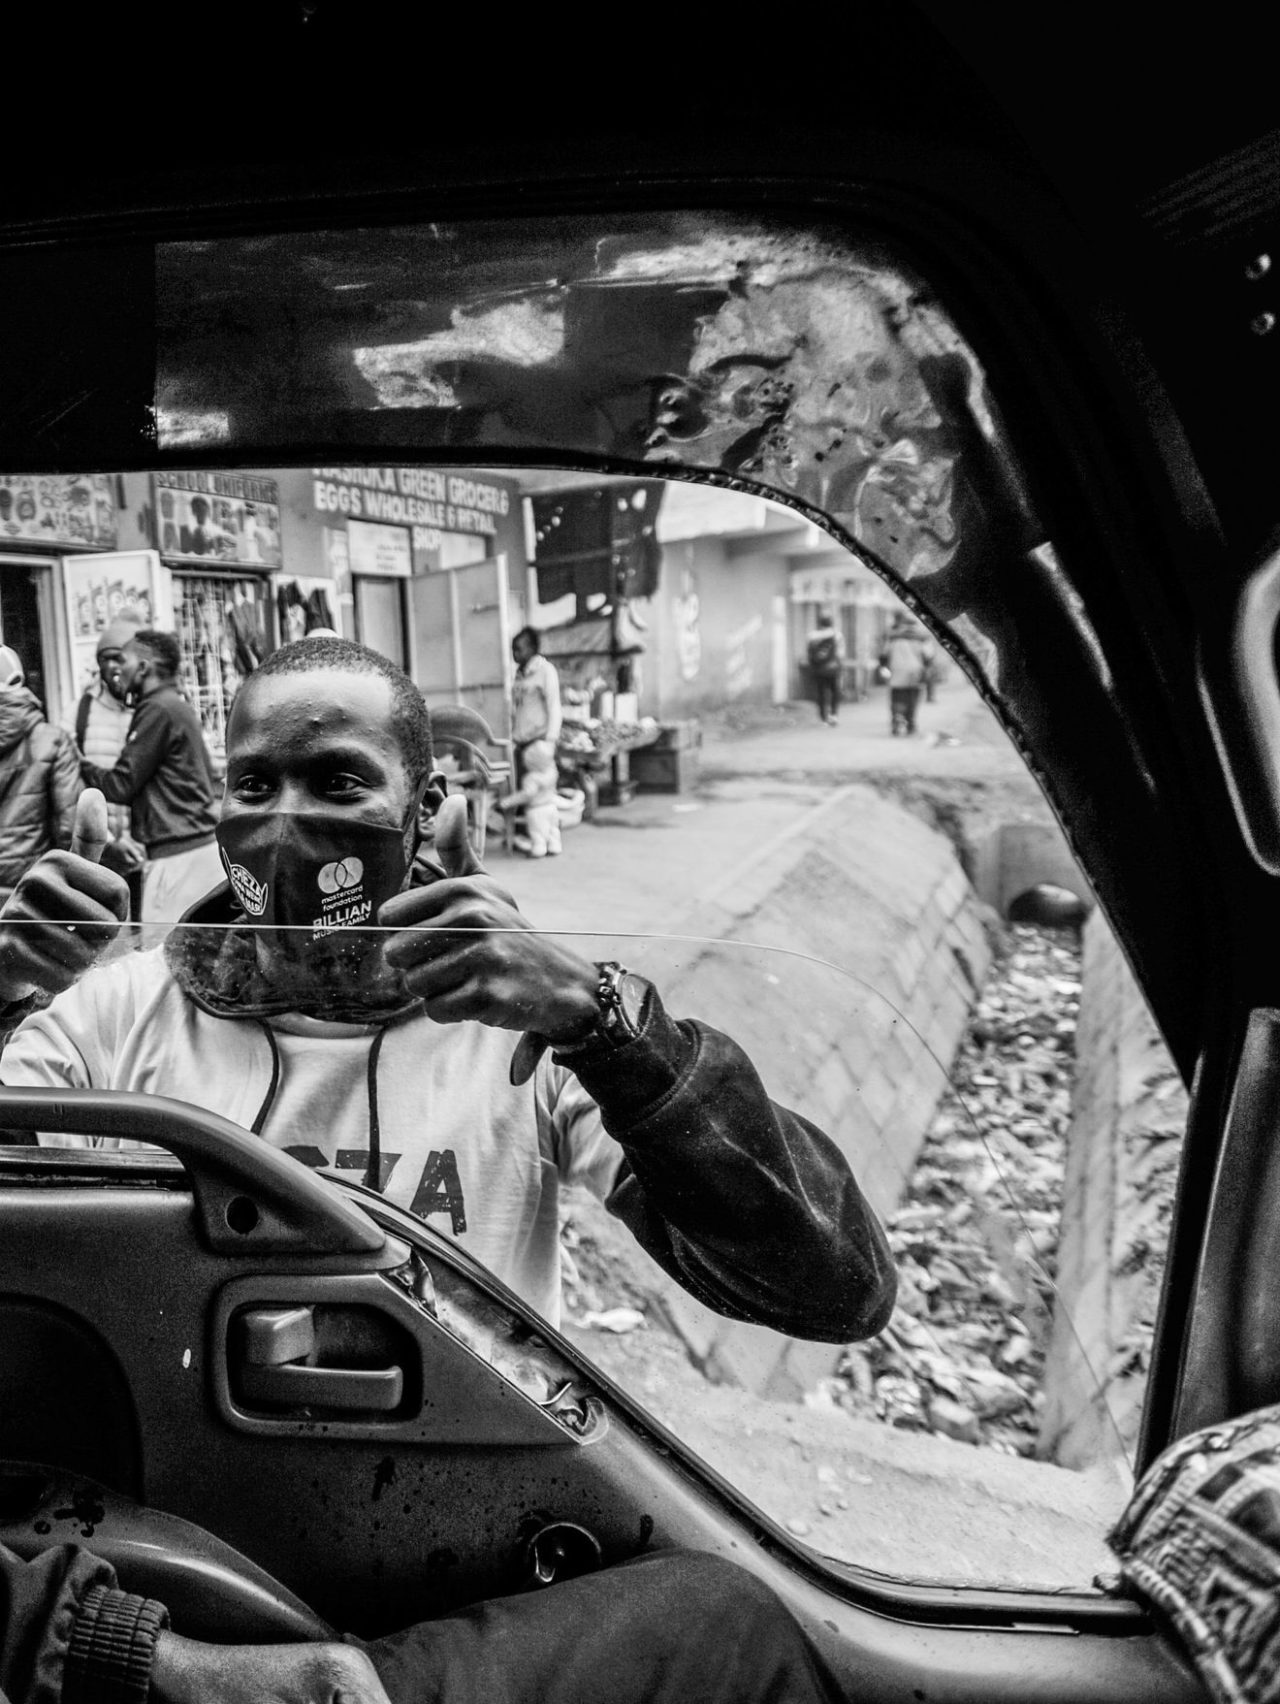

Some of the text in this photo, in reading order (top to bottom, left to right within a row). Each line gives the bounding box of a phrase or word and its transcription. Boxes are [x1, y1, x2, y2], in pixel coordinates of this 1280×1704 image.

[400, 468, 446, 503] GREEN
[314, 480, 362, 516] EGGS
[363, 489, 446, 528] WHOLESALE
[457, 507, 497, 535] RETAIL
[321, 884, 364, 905] mastercard
[322, 894, 363, 912] foundation
[312, 899, 372, 932] BILLIAN
